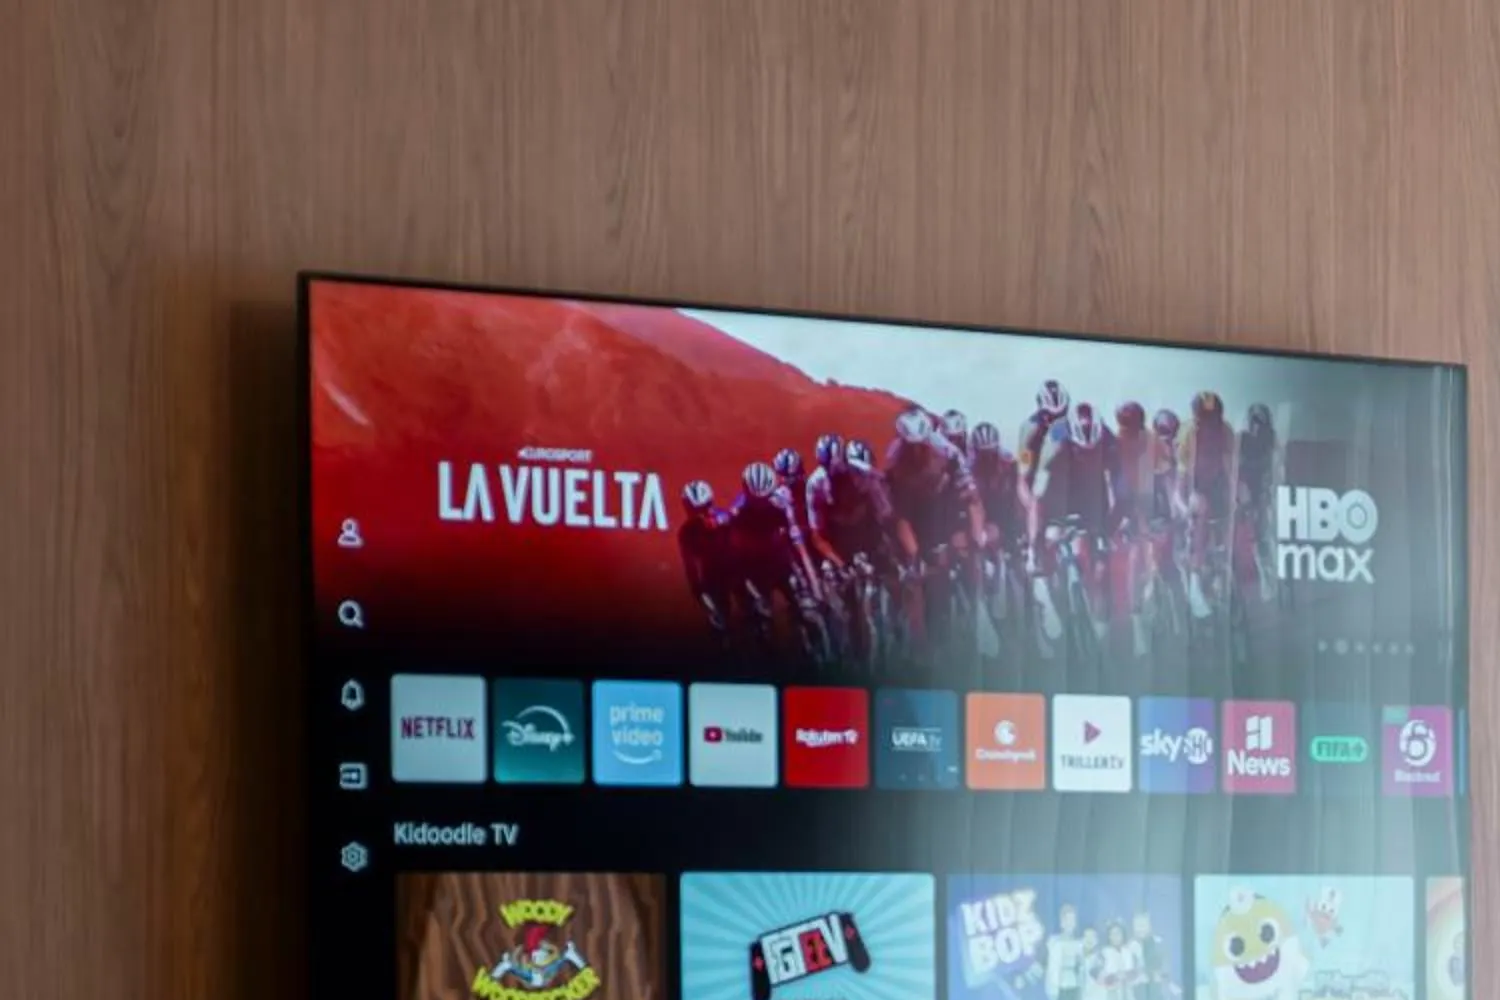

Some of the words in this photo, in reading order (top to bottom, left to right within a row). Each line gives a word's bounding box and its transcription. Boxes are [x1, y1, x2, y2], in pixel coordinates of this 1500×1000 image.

[438, 461, 495, 521] LA
[500, 466, 670, 531] VUELTA
[1277, 486, 1379, 543] HBO
[1278, 543, 1376, 583] max
[609, 701, 665, 725] prime
[401, 716, 475, 741] NETFLIX
[612, 726, 664, 747] video
[1226, 749, 1291, 777] News
[393, 822, 487, 845] Kidoodle
[491, 824, 519, 845] TV
[500, 899, 574, 928] WOODY
[960, 889, 1037, 936] KIDZ
[968, 915, 1045, 974] BOP
